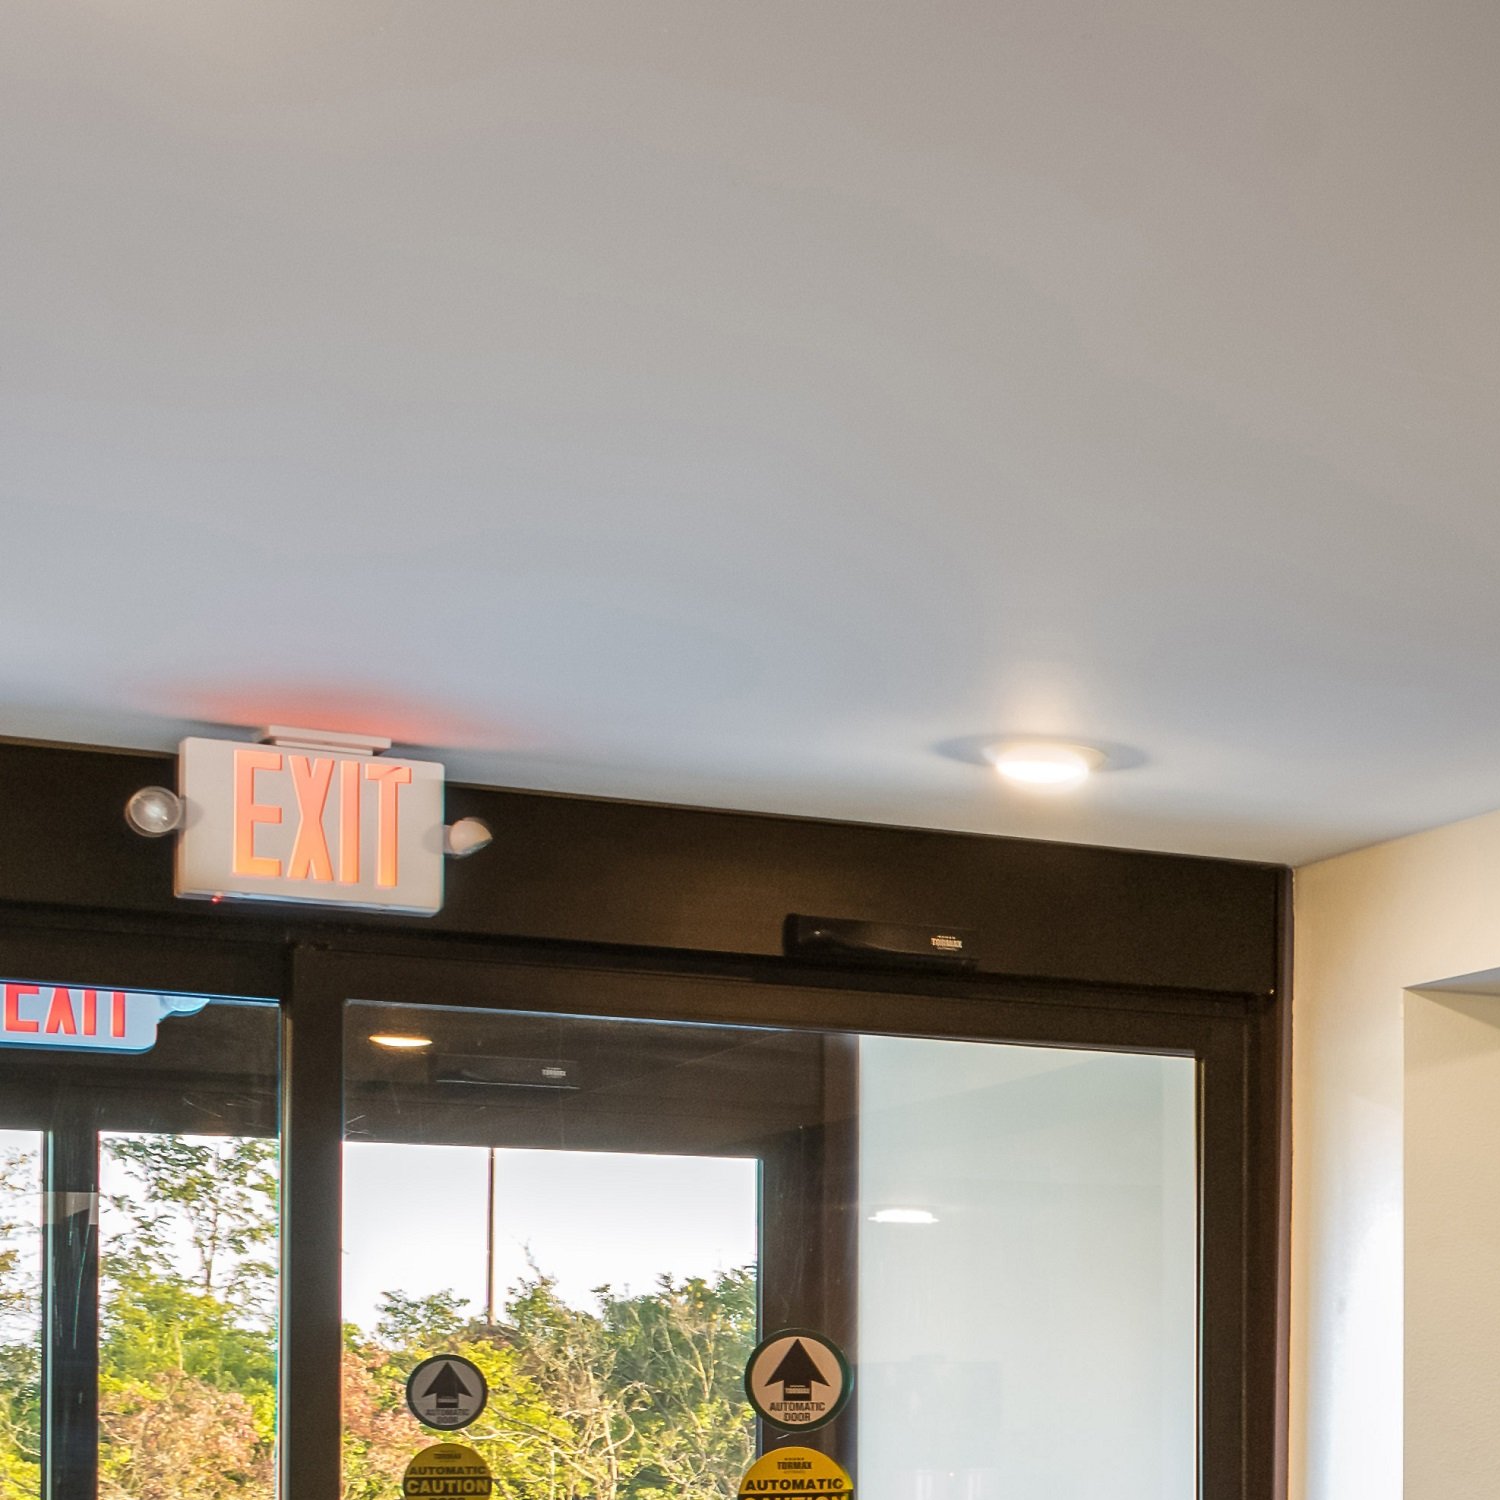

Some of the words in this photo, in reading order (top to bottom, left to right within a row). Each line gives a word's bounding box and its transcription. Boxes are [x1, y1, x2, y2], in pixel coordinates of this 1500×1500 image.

[233, 749, 412, 888] EXIT
[770, 1402, 826, 1412] AUTOMATIC
[784, 1412, 811, 1422] DOOR
[409, 1466, 487, 1475] AUTOMATIC
[406, 1479, 489, 1494] CAUTION
[745, 1478, 844, 1491] AUTOMATIC
